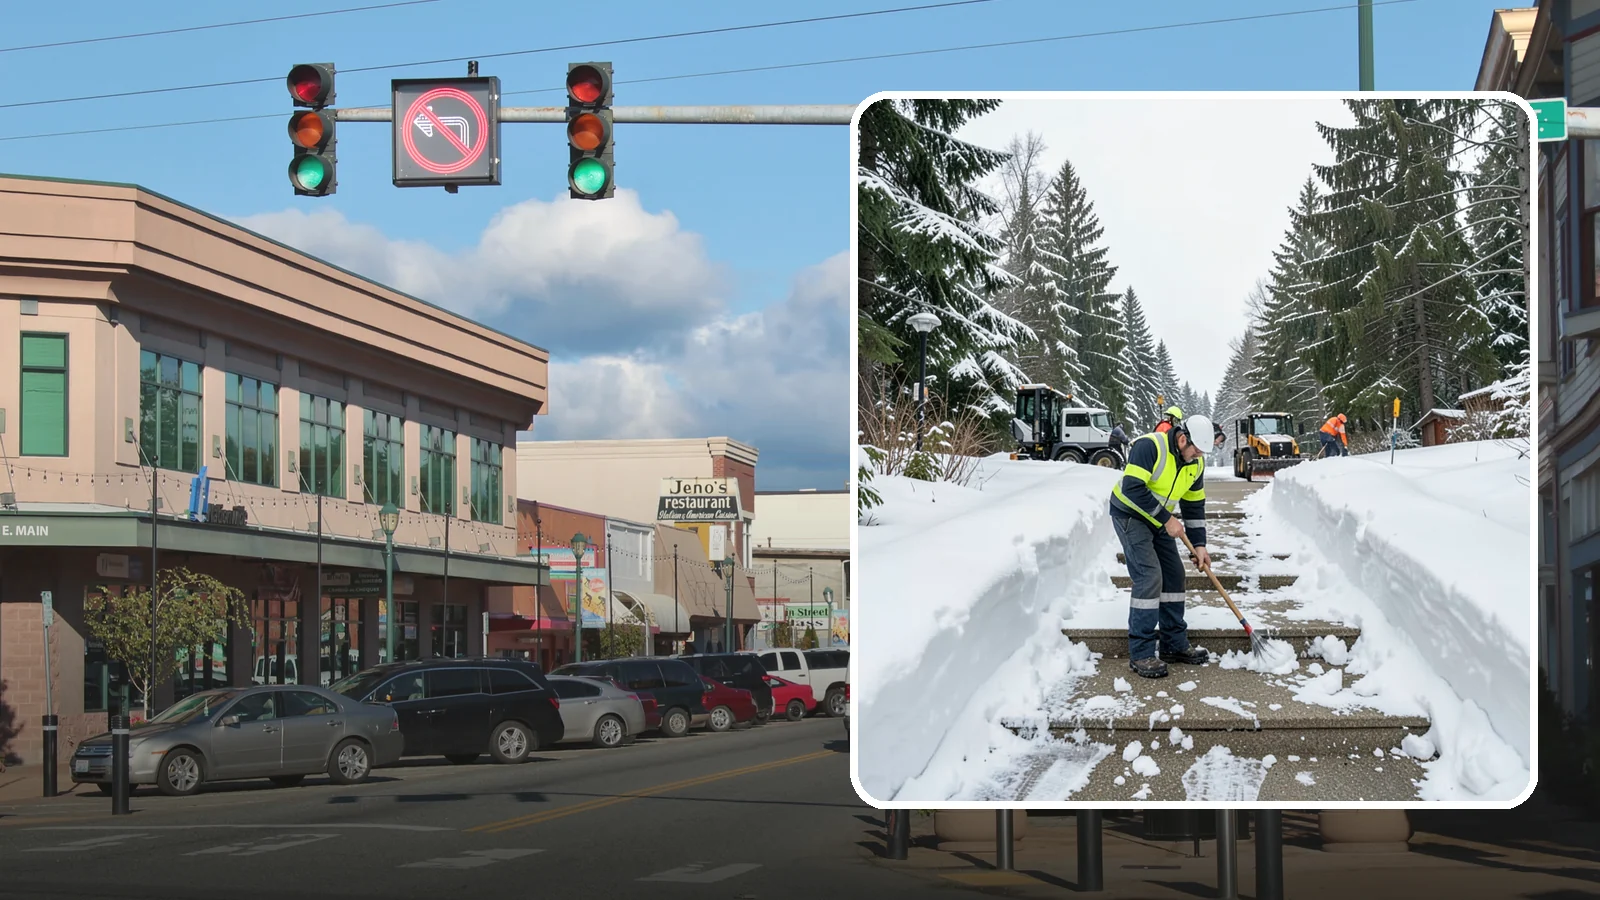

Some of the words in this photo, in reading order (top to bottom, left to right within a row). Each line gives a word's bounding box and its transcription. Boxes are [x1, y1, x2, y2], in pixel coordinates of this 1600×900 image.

[670, 480, 727, 494] Jeno's
[665, 496, 731, 509] restaurant
[658, 510, 681, 519] Italian
[686, 510, 714, 519] American
[715, 509, 737, 519] Cuisine
[2, 525, 13, 536] E.
[15, 525, 49, 536] MAIN
[786, 607, 795, 616] in
[798, 607, 828, 617] Street
